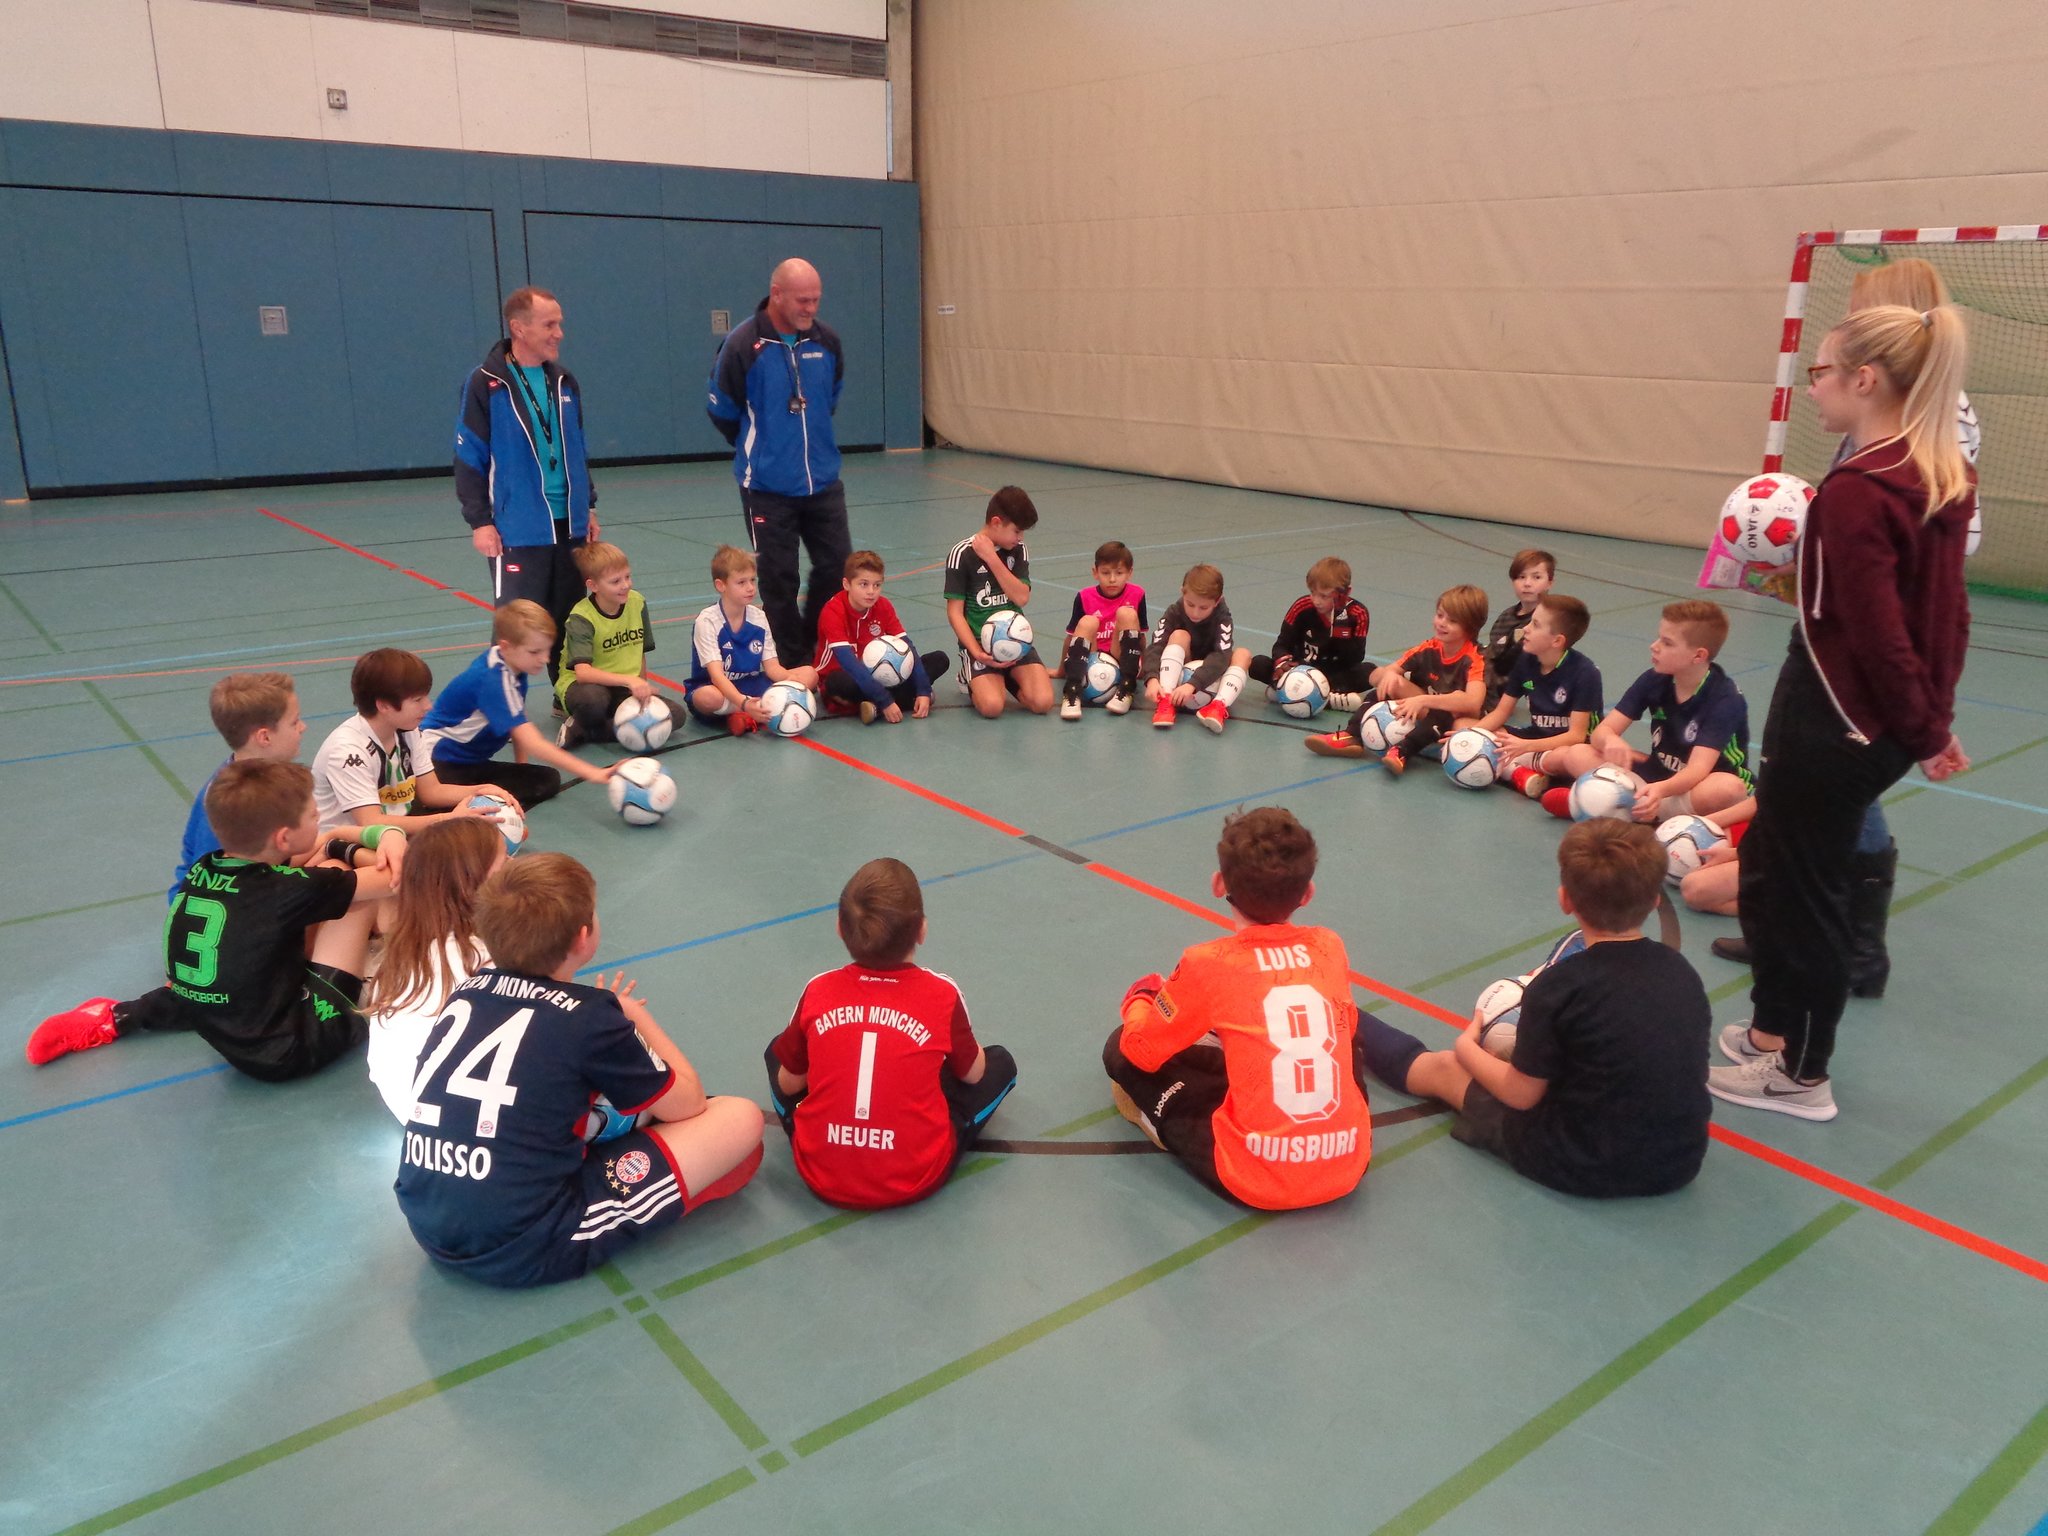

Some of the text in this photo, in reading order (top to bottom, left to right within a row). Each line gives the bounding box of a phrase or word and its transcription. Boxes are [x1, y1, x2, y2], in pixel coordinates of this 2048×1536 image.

[1747, 518, 1758, 549] JAKO
[602, 627, 644, 649] adidas
[1253, 944, 1312, 972] LUIS
[491, 975, 582, 1012] MÜNCHEN
[815, 1005, 932, 1048] BAYERN MÜNCHEN
[408, 998, 536, 1139] 24
[1262, 984, 1341, 1124] 8
[854, 1031, 878, 1120] 1
[1153, 1081, 1185, 1118] uhlsport
[827, 1122, 896, 1150] NEUER
[404, 1131, 492, 1181] TOLISSO
